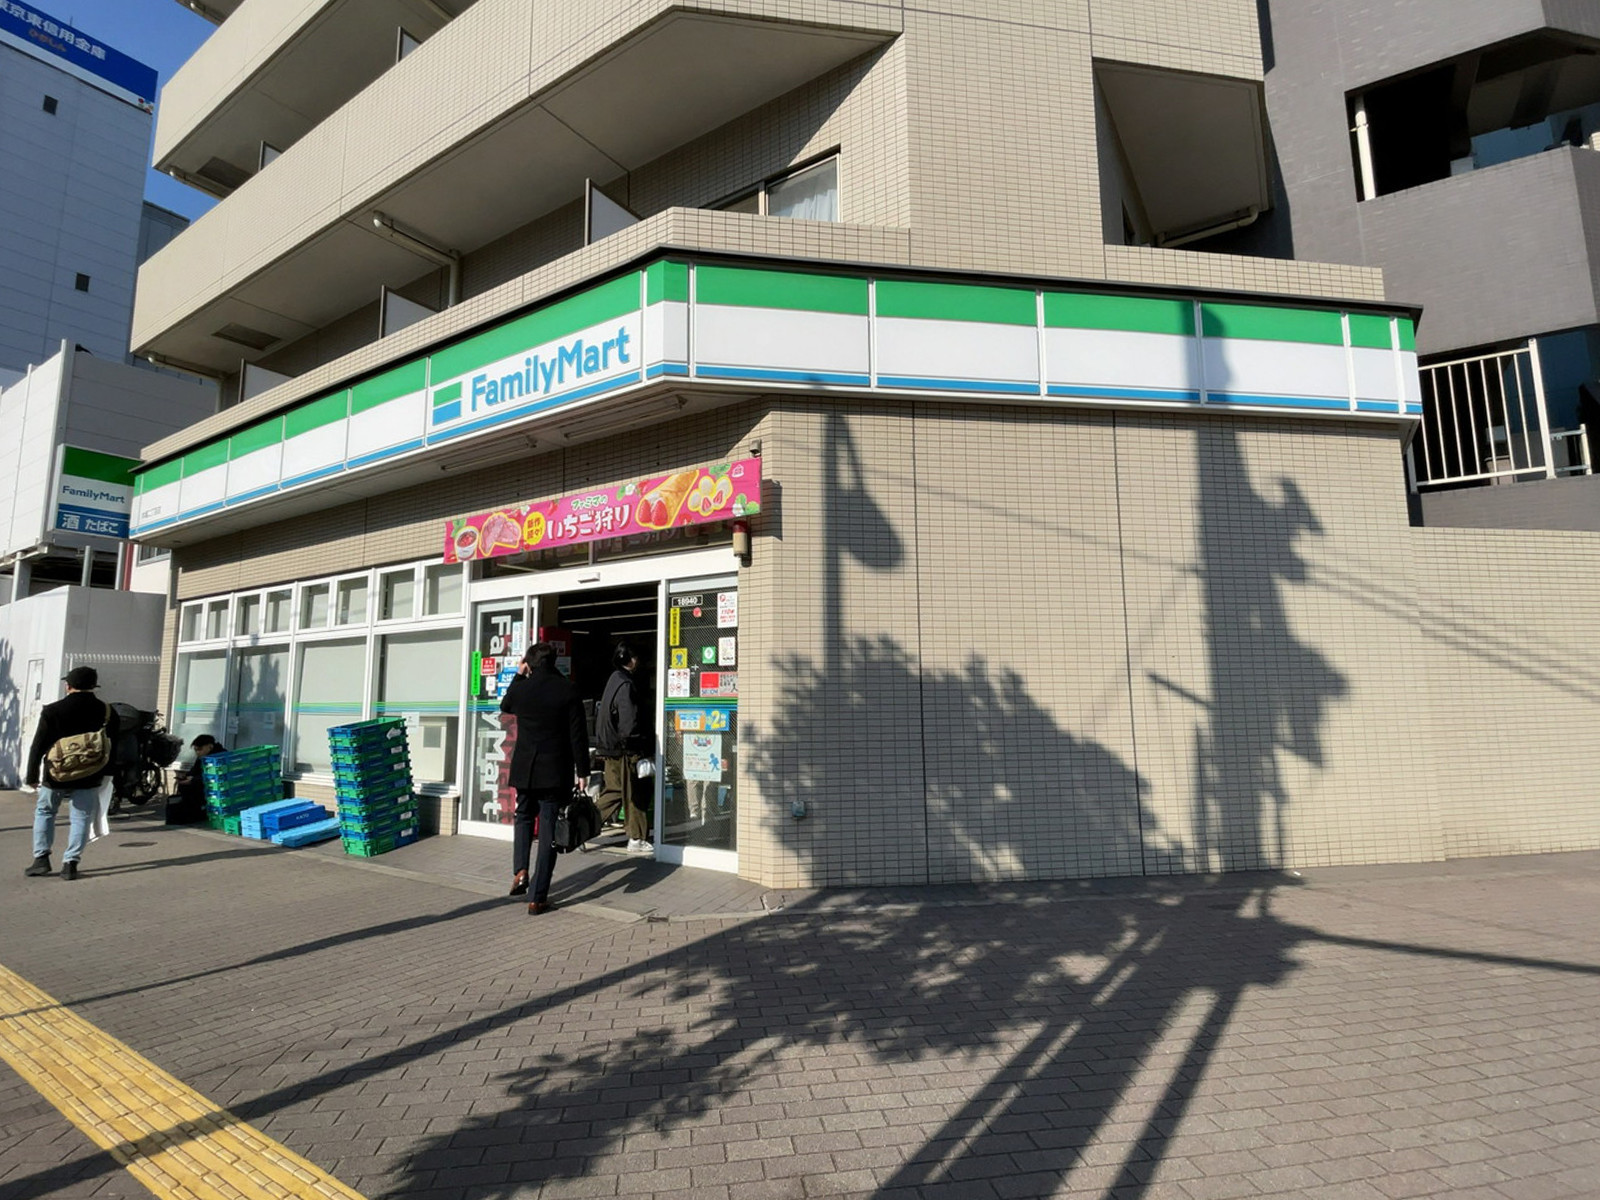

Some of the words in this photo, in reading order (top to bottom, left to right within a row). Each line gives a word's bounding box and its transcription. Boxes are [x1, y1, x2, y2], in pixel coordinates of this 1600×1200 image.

[472, 326, 630, 412] FamilyMart
[62, 485, 125, 504] FamilyMart
[571, 494, 608, 511] ファミマの
[62, 513, 80, 530] 酒
[85, 518, 120, 534] たばこ
[547, 503, 631, 540] いちご狩り
